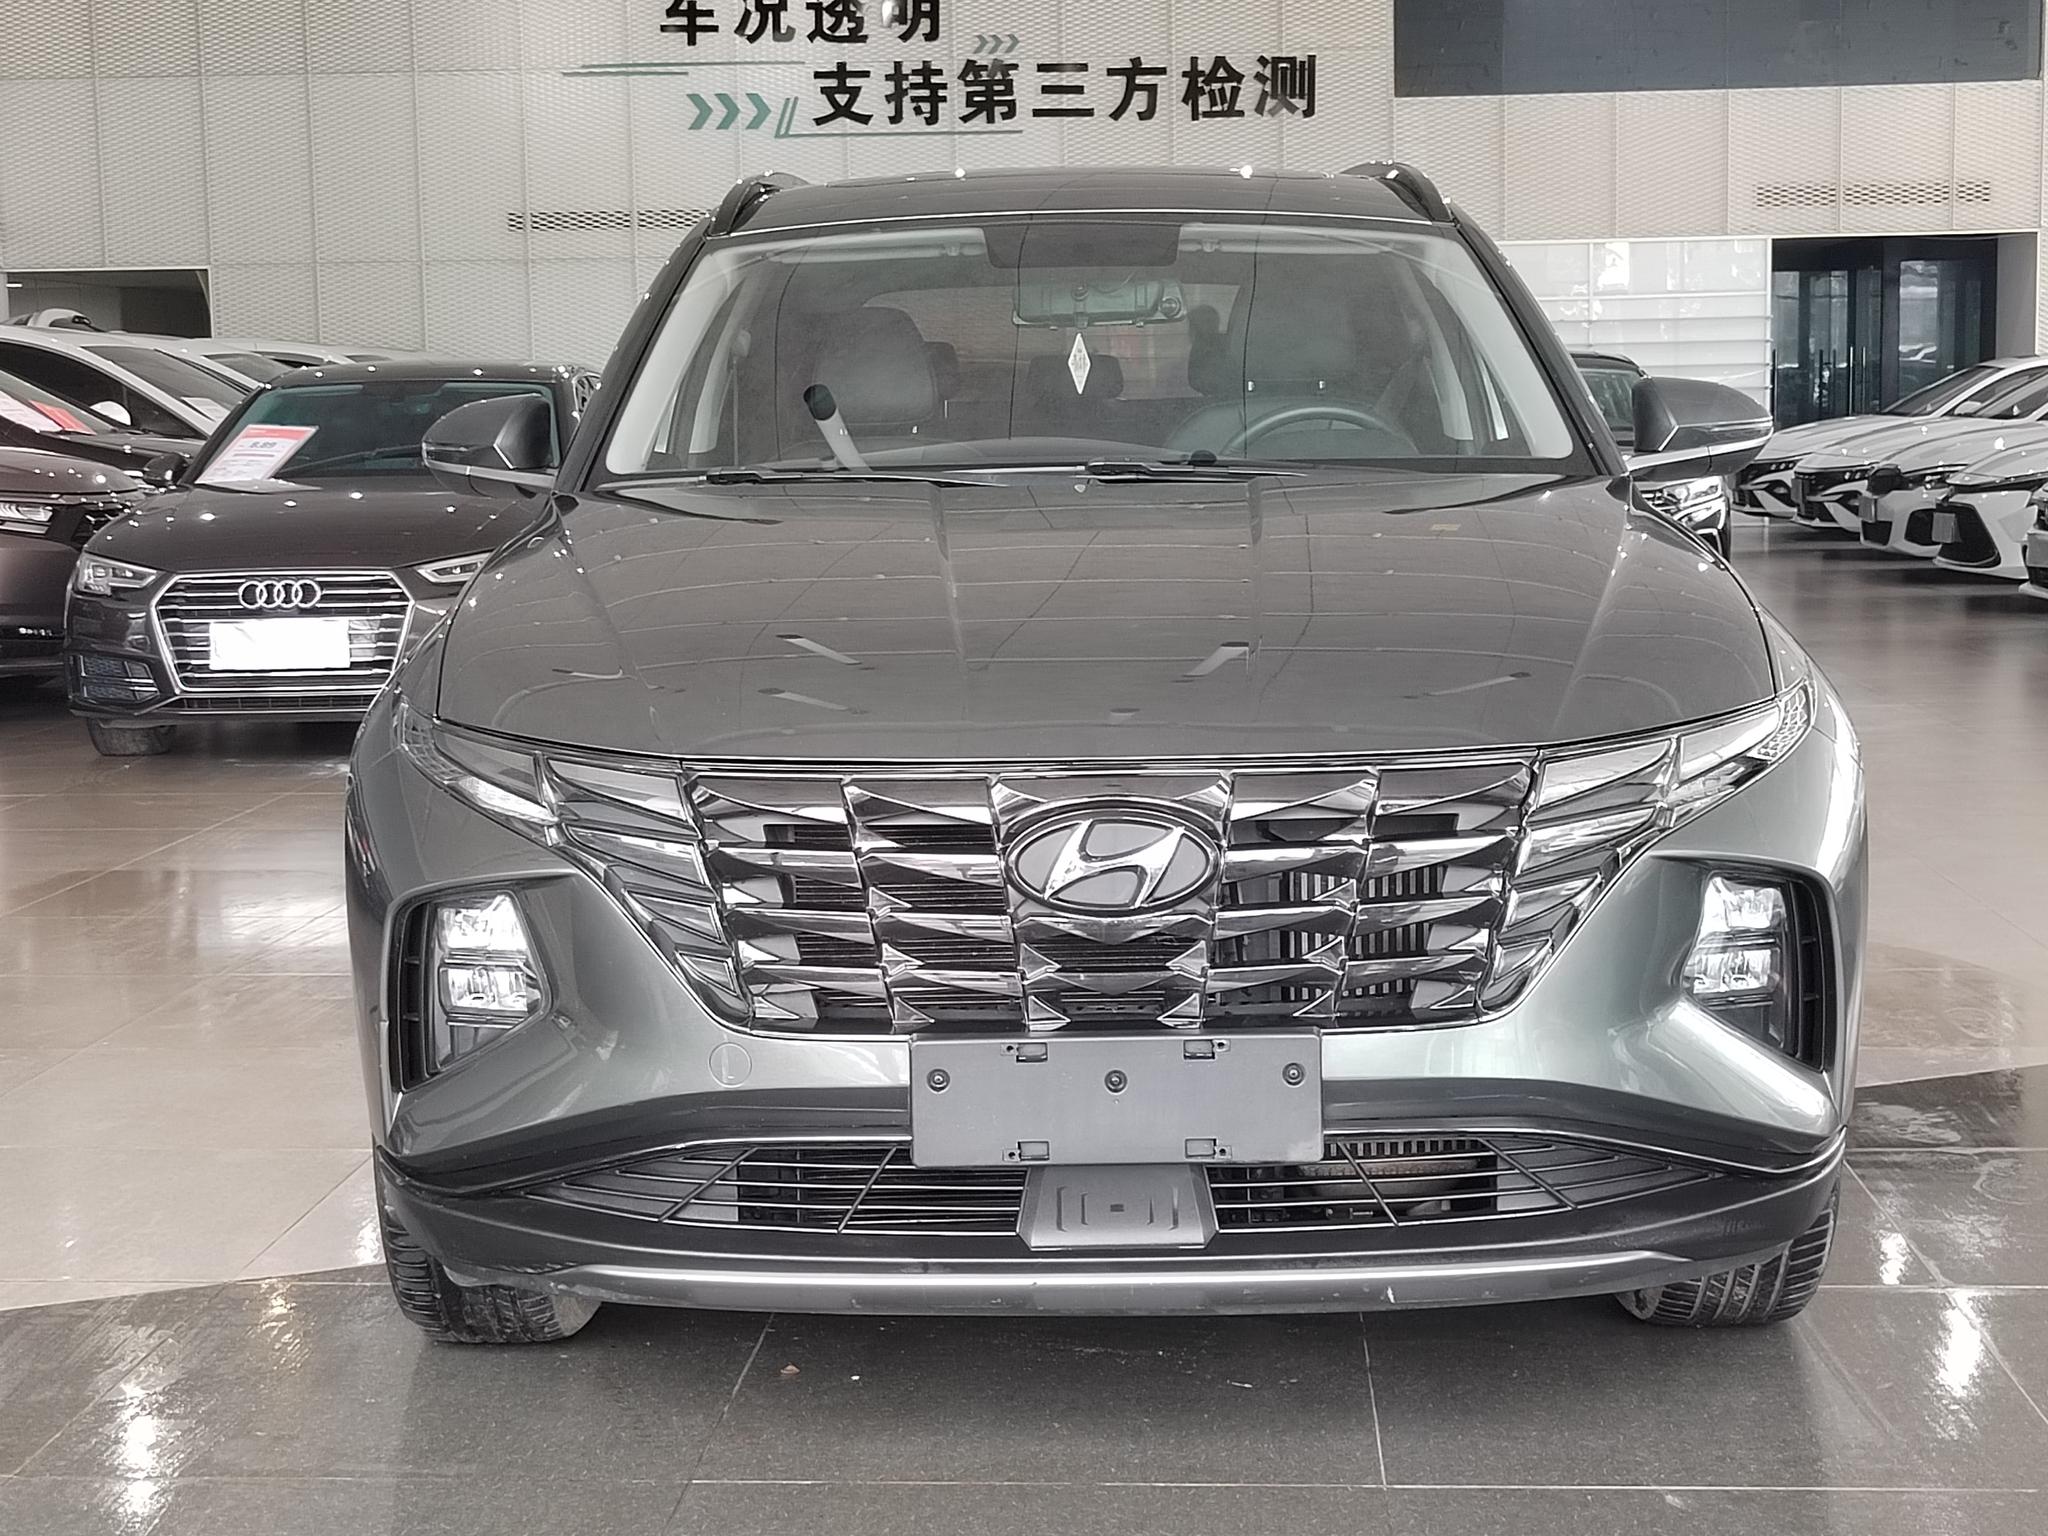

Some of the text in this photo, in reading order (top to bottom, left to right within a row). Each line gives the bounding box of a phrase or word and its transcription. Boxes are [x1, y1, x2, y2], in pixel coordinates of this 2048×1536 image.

[812, 54, 1317, 126] 支持第三方检测
